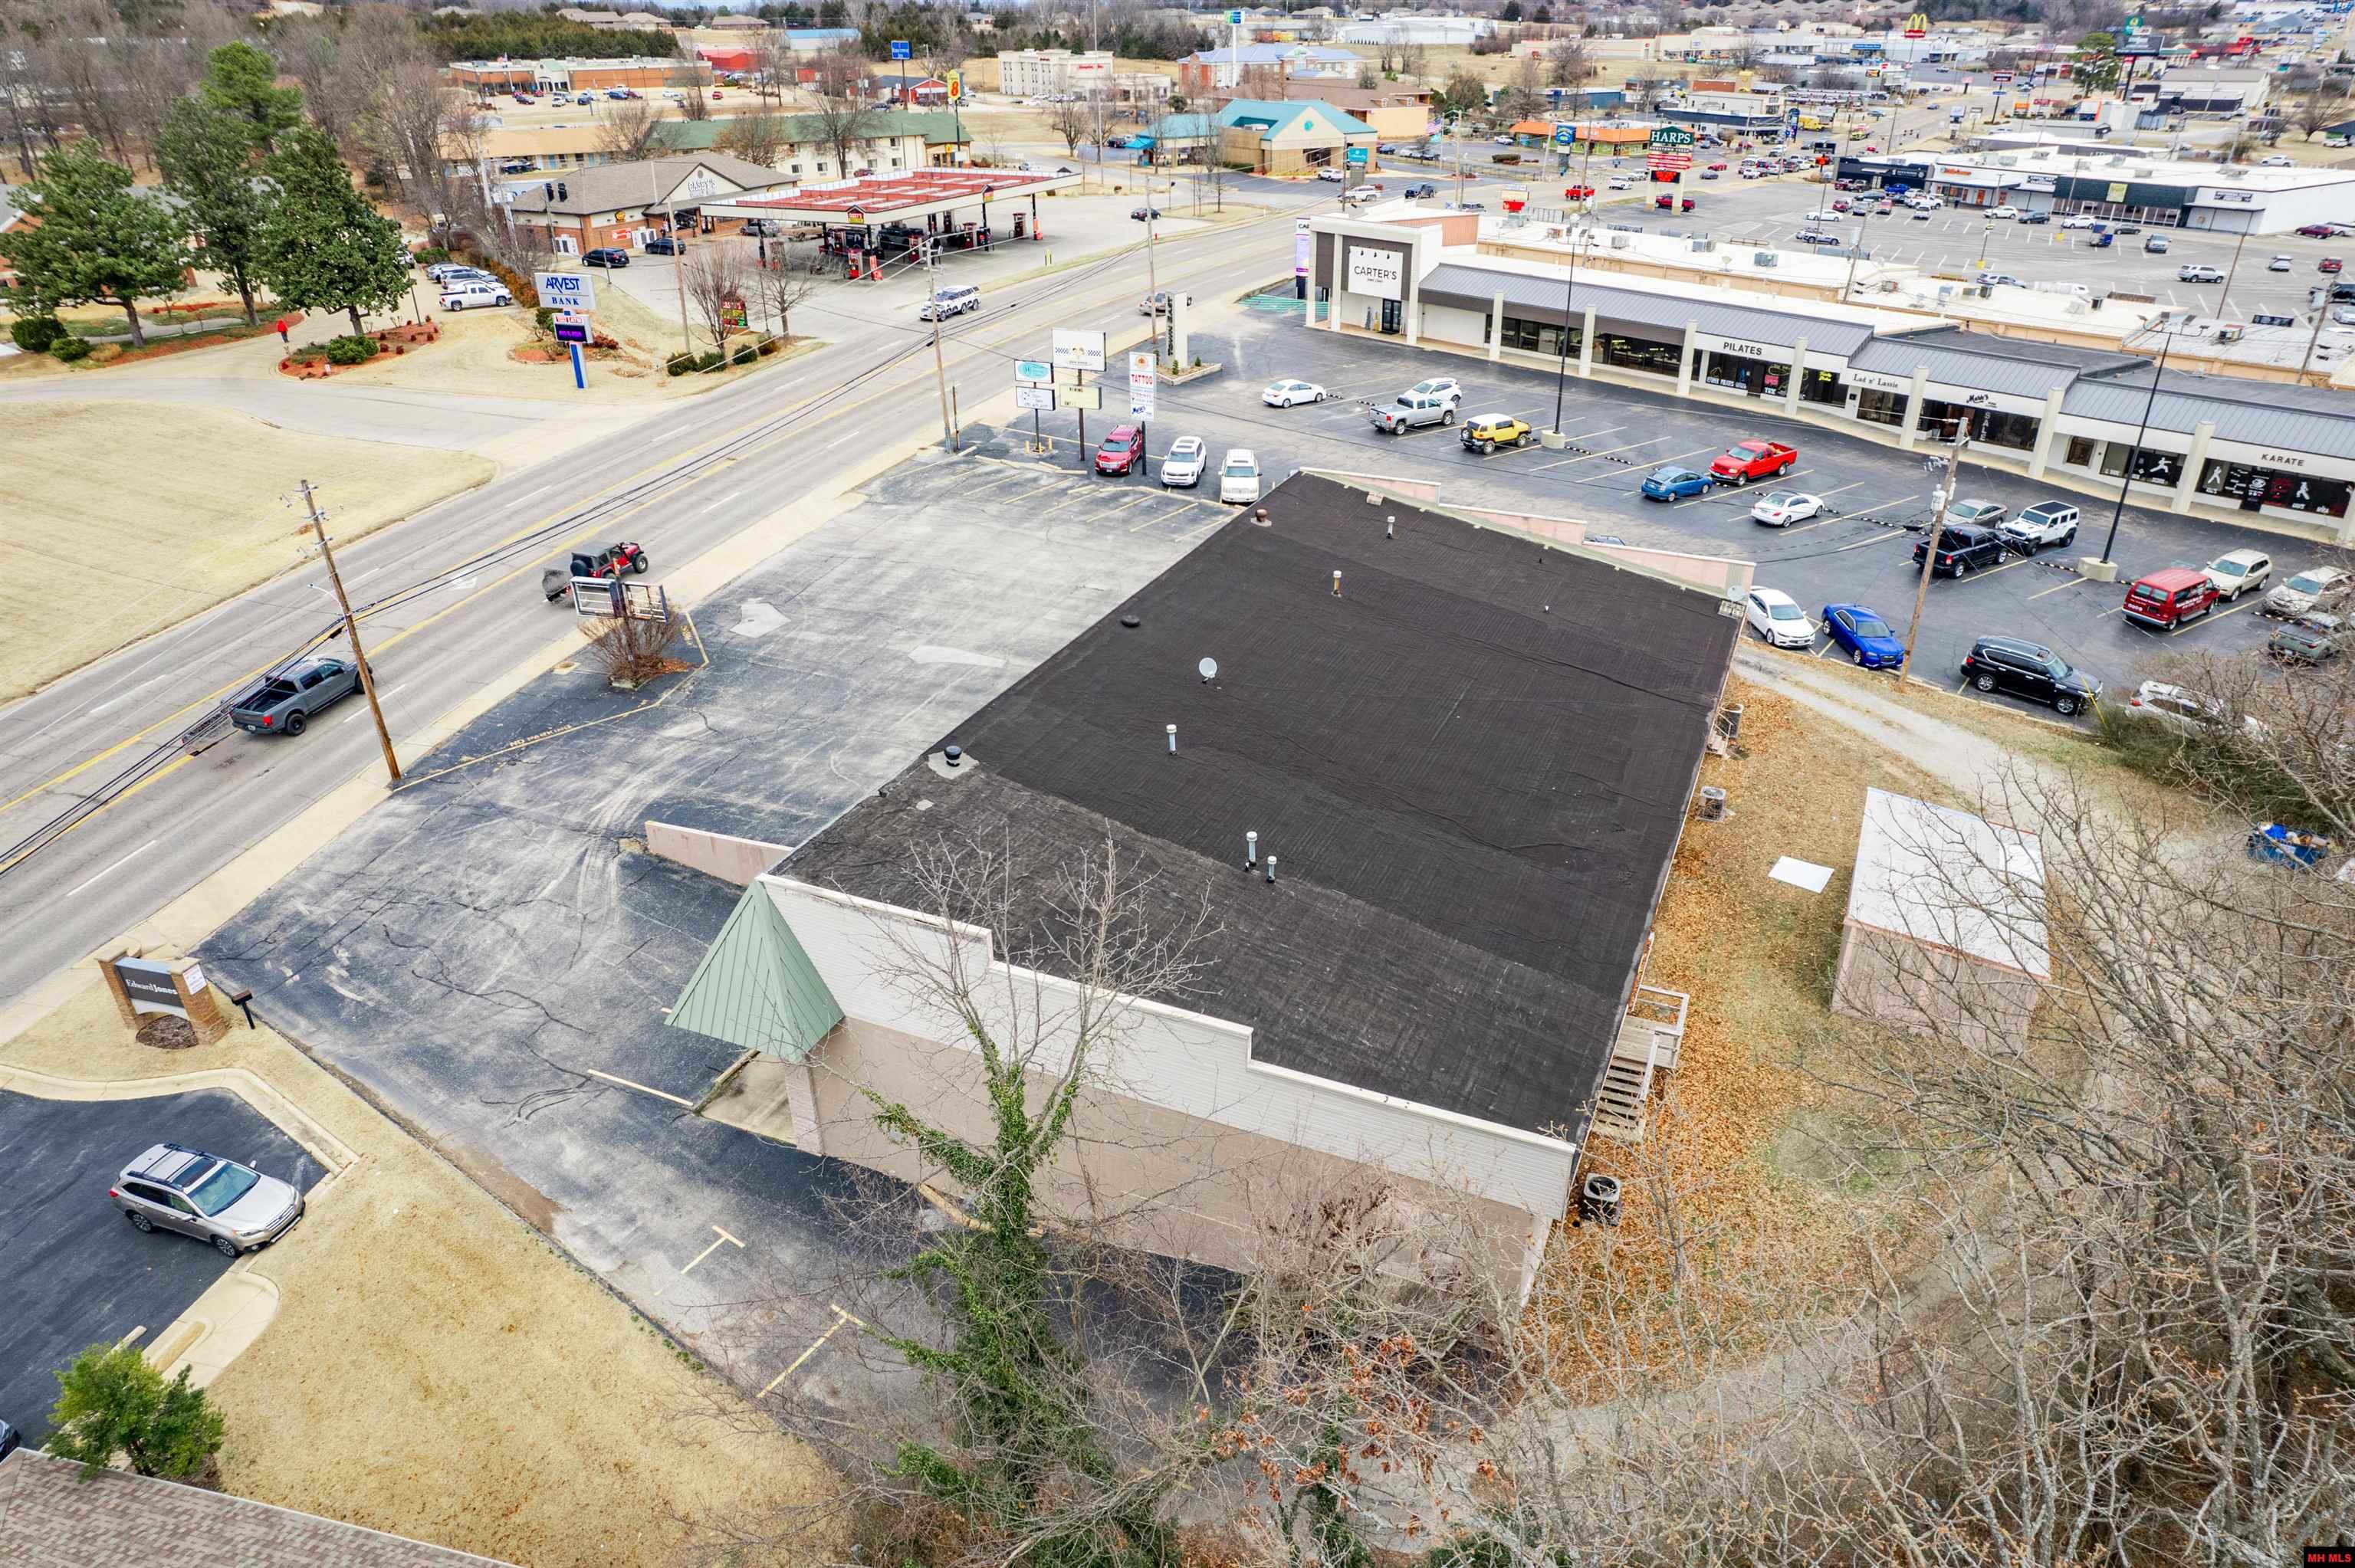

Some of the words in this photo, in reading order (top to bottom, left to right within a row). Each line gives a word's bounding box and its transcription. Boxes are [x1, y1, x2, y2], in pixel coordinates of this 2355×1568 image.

[951, 80, 959, 97] 8
[1651, 131, 1690, 144] HARPS
[1354, 265, 1398, 280] CARTER'S
[546, 277, 580, 294] ARVEST
[552, 297, 580, 306] BANK
[1723, 342, 1762, 356] PILATES
[1131, 373, 1153, 385] TATTOO
[1877, 377, 1898, 389] Lassie
[1979, 412, 1991, 442] SALE
[2261, 454, 2305, 467] KARATE
